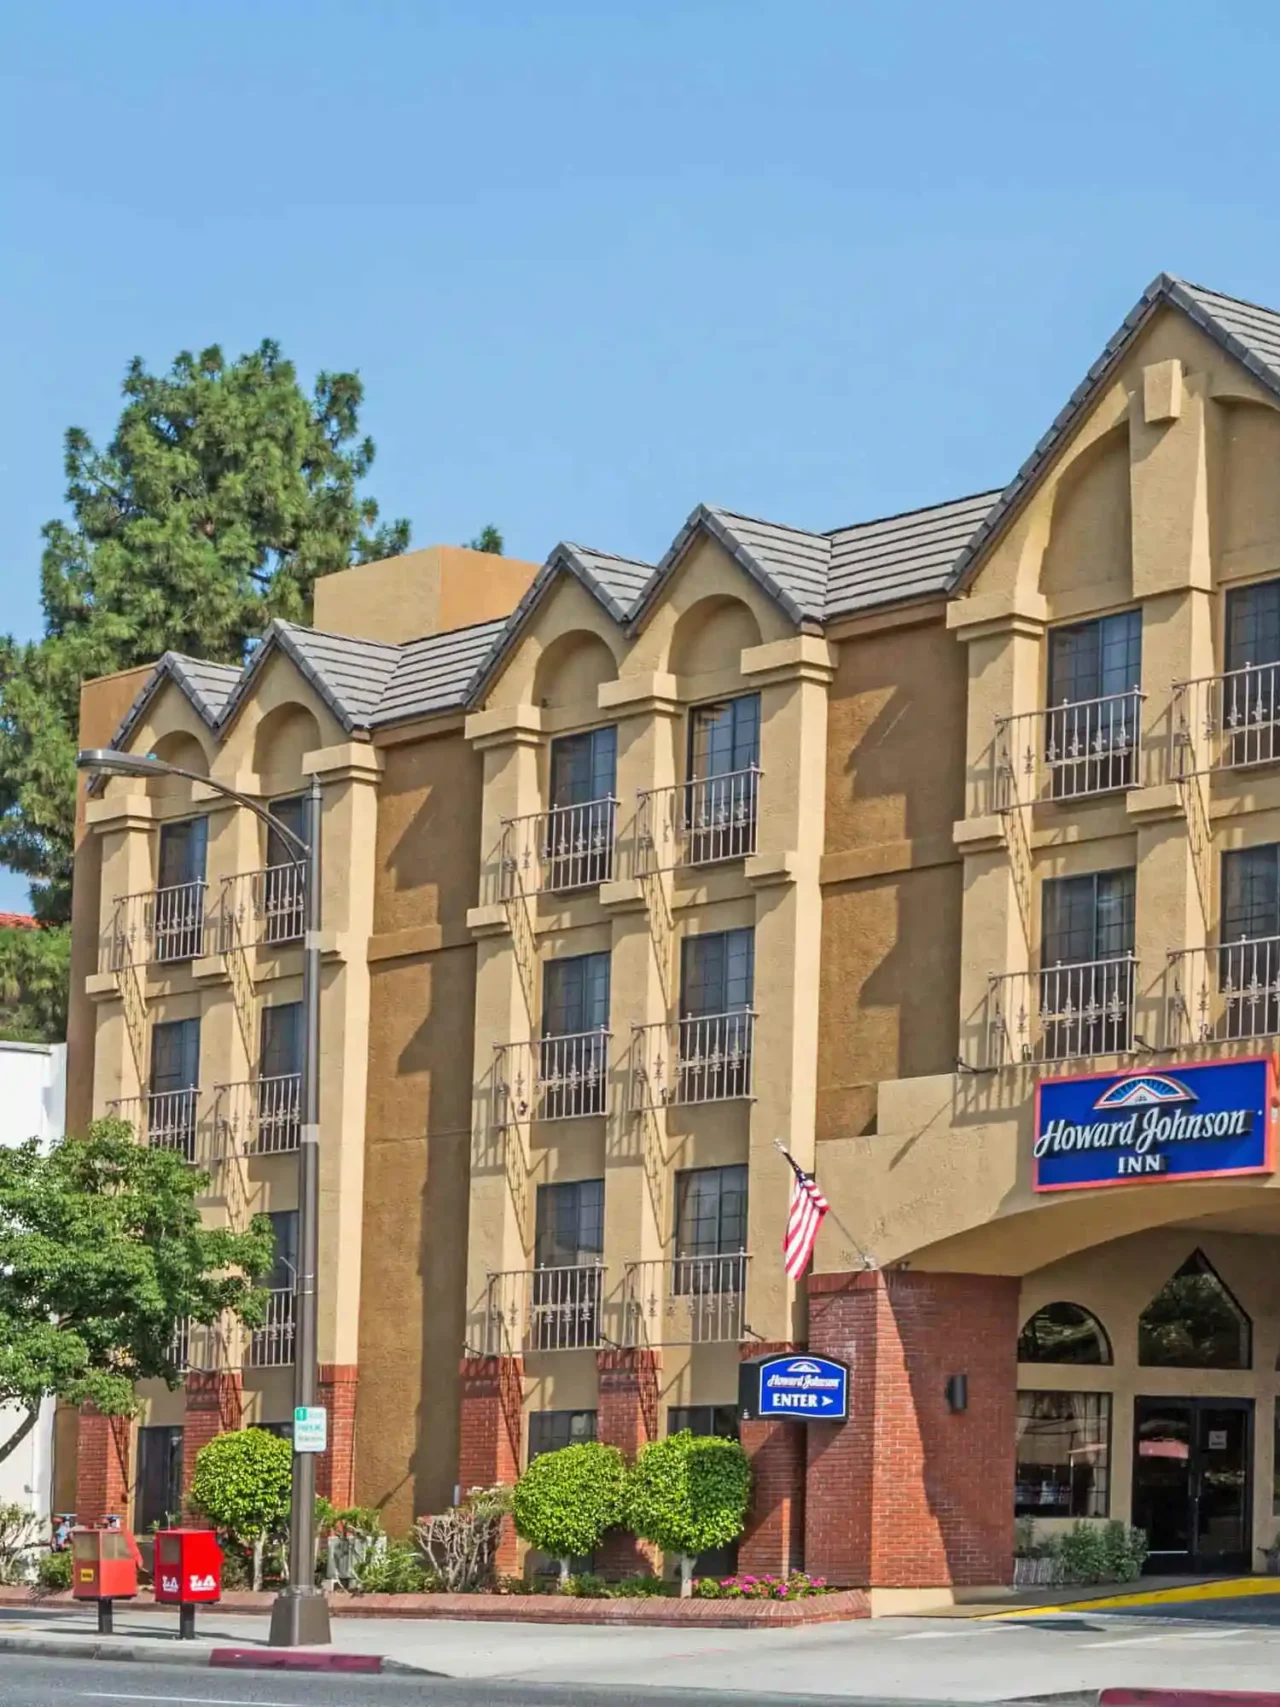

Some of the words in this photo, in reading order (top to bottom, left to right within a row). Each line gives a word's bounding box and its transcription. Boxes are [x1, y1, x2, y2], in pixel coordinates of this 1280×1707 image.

[1033, 1112, 1138, 1158] Howard
[1136, 1106, 1247, 1154] Johnson
[1118, 1154, 1161, 1174] INN
[772, 1393, 818, 1407] ENTER
